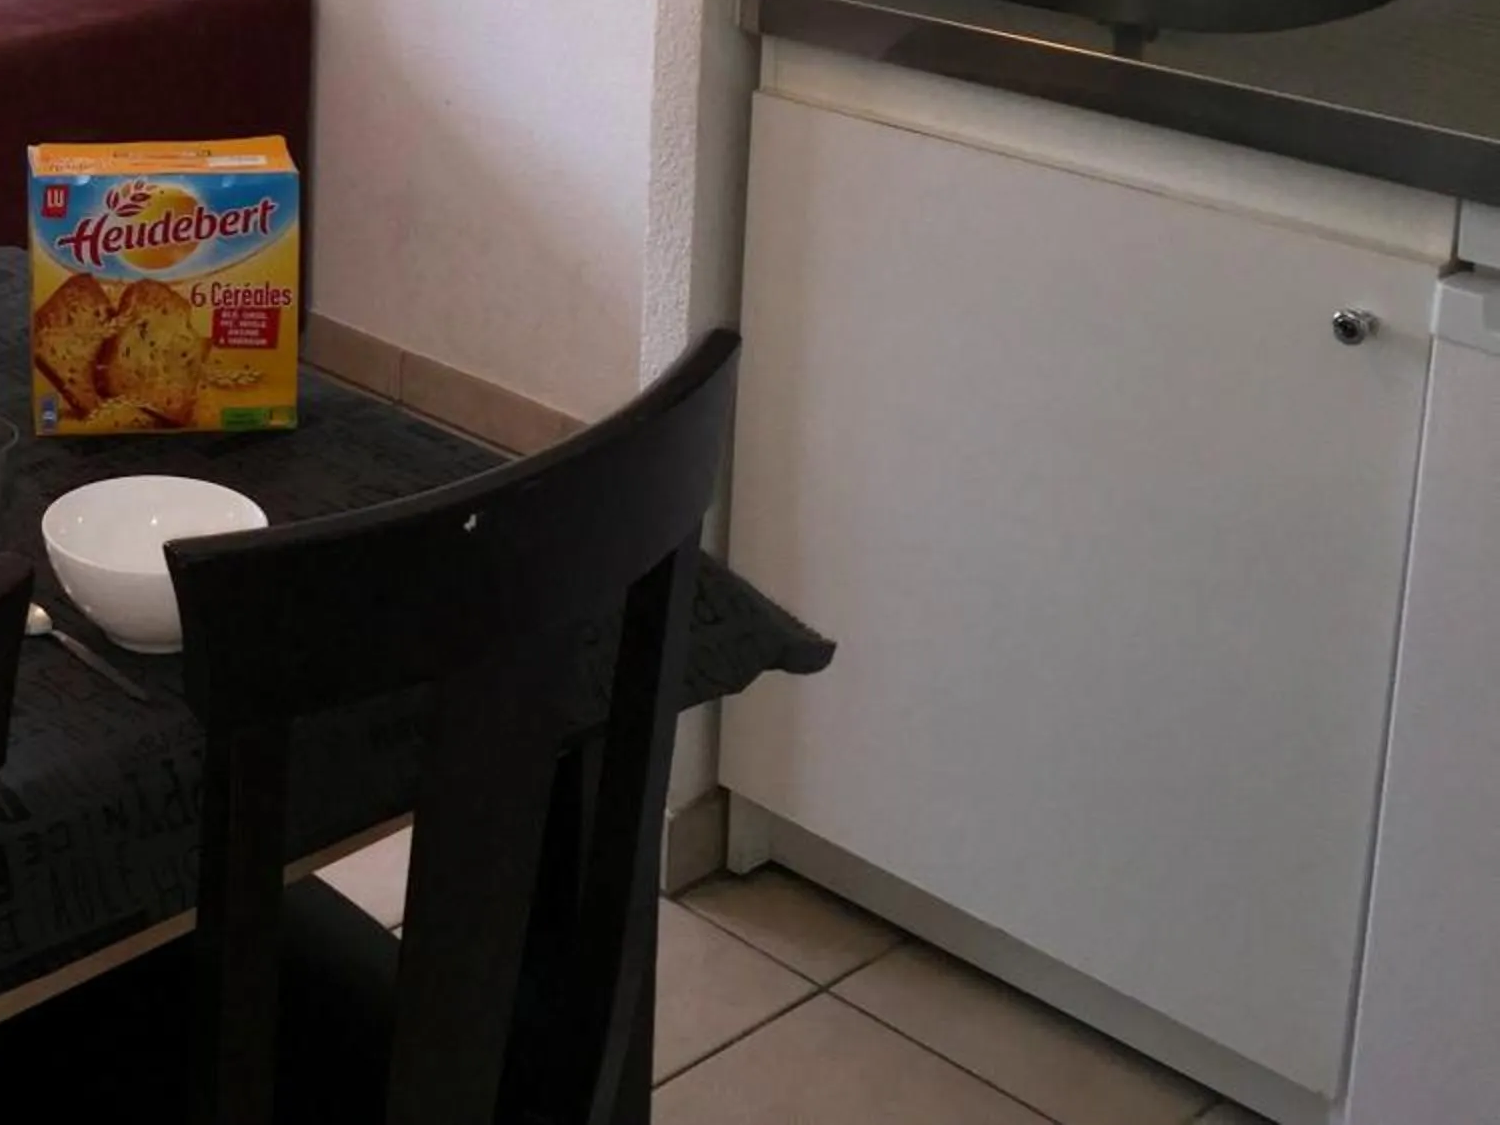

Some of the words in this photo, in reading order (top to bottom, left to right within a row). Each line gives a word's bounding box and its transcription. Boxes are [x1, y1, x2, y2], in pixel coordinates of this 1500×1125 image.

[47, 188, 66, 208] LU
[58, 198, 277, 267] Heudebert
[190, 286, 206, 307] 6
[211, 281, 291, 308] Céréales
